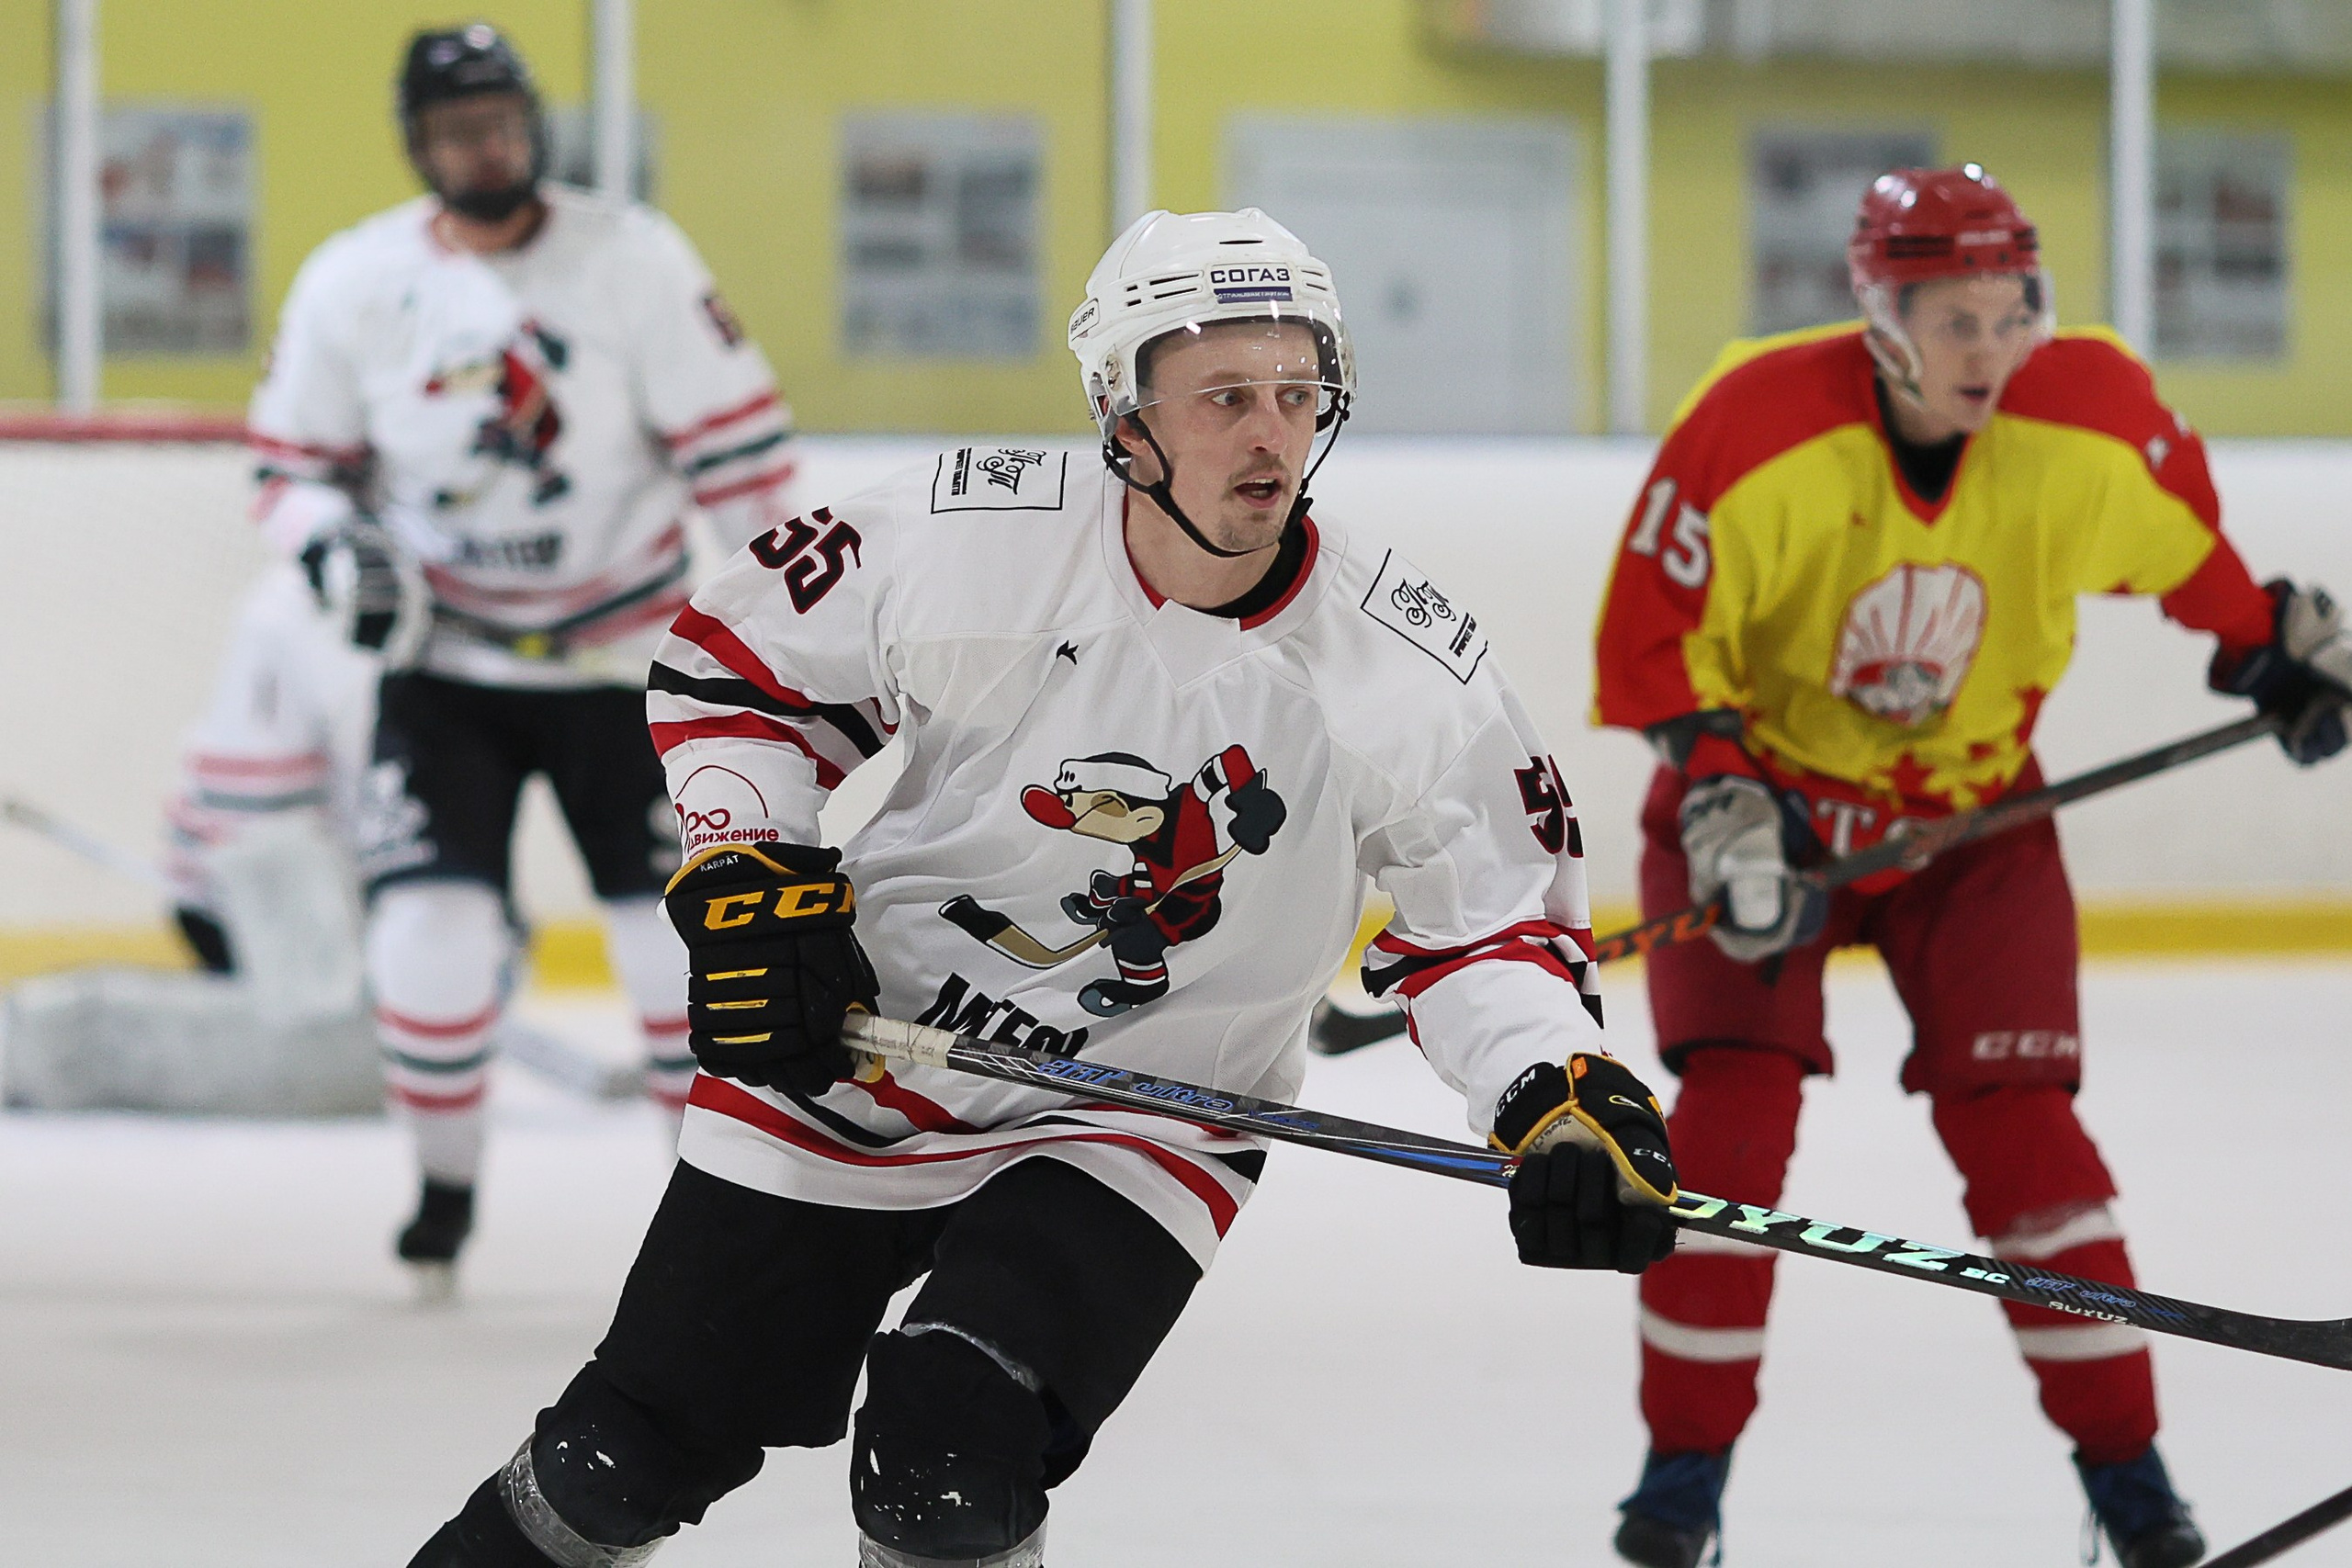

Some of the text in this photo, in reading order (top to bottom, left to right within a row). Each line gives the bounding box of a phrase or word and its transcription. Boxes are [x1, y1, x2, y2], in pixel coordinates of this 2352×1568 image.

[1210, 267, 1290, 284] СОГАЗ
[1628, 475, 1713, 590] 15
[1497, 1067, 1536, 1118] CCM
[1633, 1148, 1673, 1171] CC
